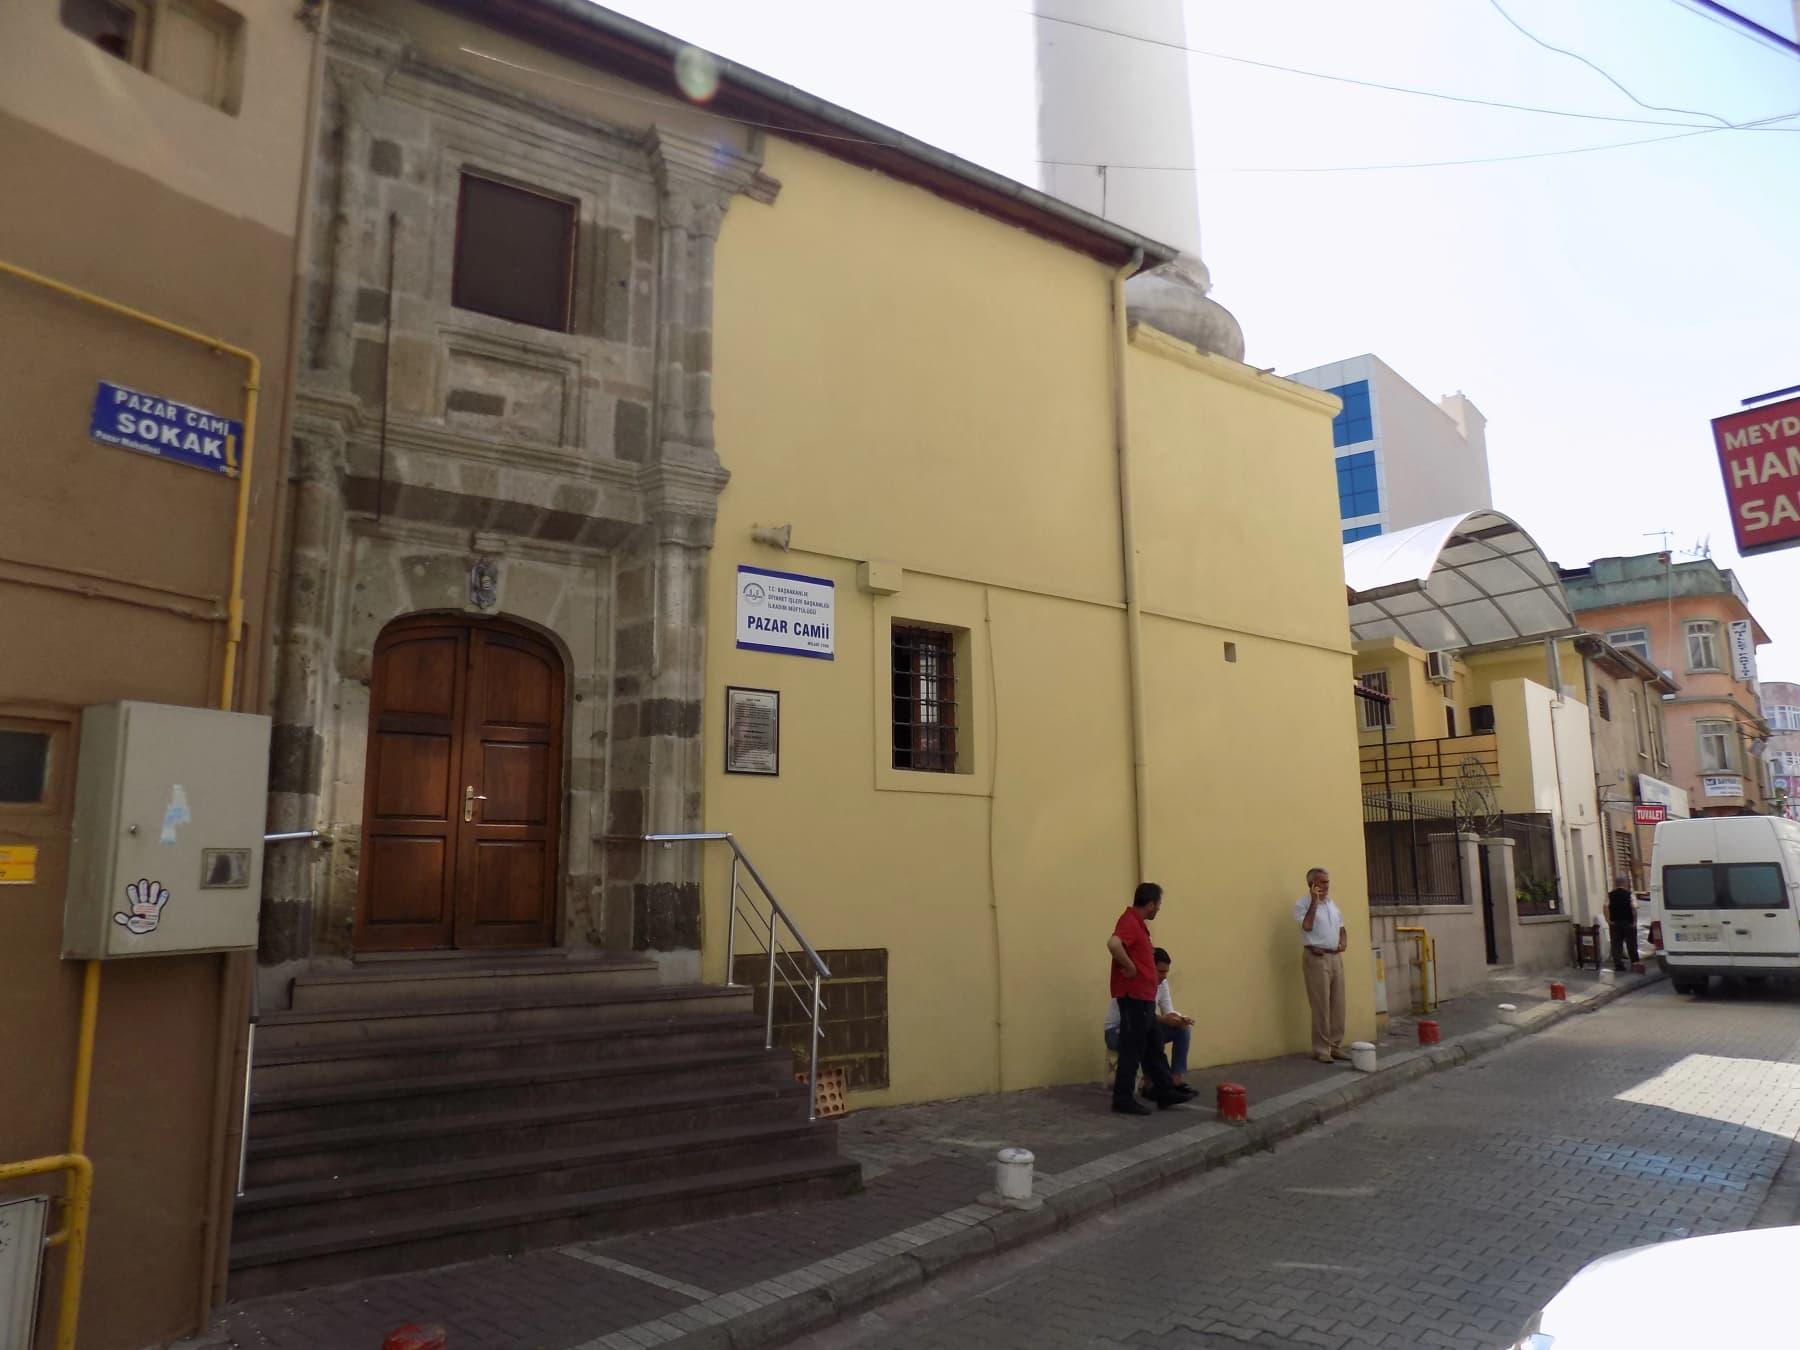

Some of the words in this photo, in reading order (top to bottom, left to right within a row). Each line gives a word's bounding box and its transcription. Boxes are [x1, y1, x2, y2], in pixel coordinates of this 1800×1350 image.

[114, 390, 177, 421] PAZAR
[186, 412, 230, 436] CAMİ
[117, 413, 224, 459] SOKAK
[1724, 416, 1800, 450] MEYD
[1740, 491, 1800, 532] SA
[747, 615, 788, 634] PAZAR
[793, 622, 830, 640] CAMİİ
[1637, 809, 1663, 820] TUVALET
